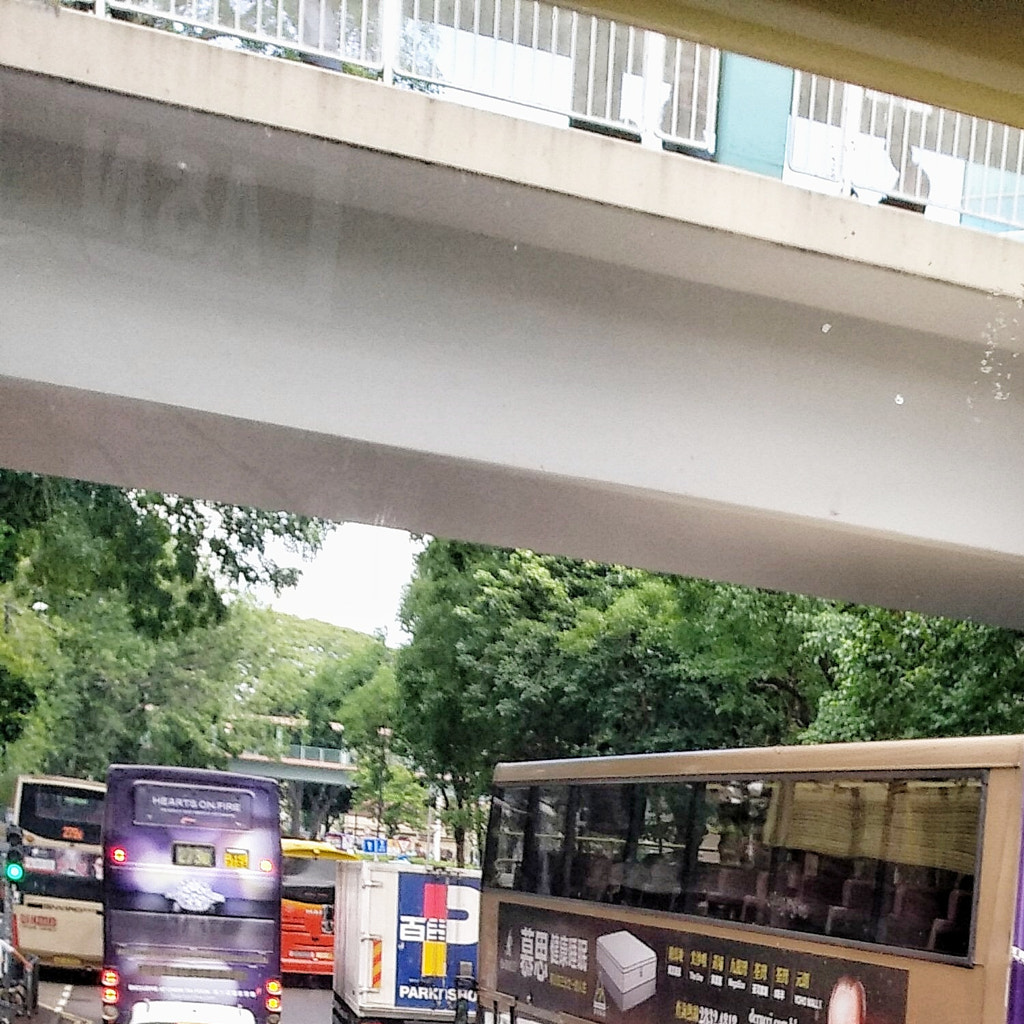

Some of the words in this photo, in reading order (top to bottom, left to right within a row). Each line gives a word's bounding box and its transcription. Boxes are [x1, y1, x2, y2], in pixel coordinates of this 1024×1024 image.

[152, 796, 197, 808] HEARTS
[198, 799, 216, 809] ON
[215, 801, 241, 812] FIRE
[399, 915, 447, 942] 百佳
[399, 984, 478, 1002] PARKnSHO
